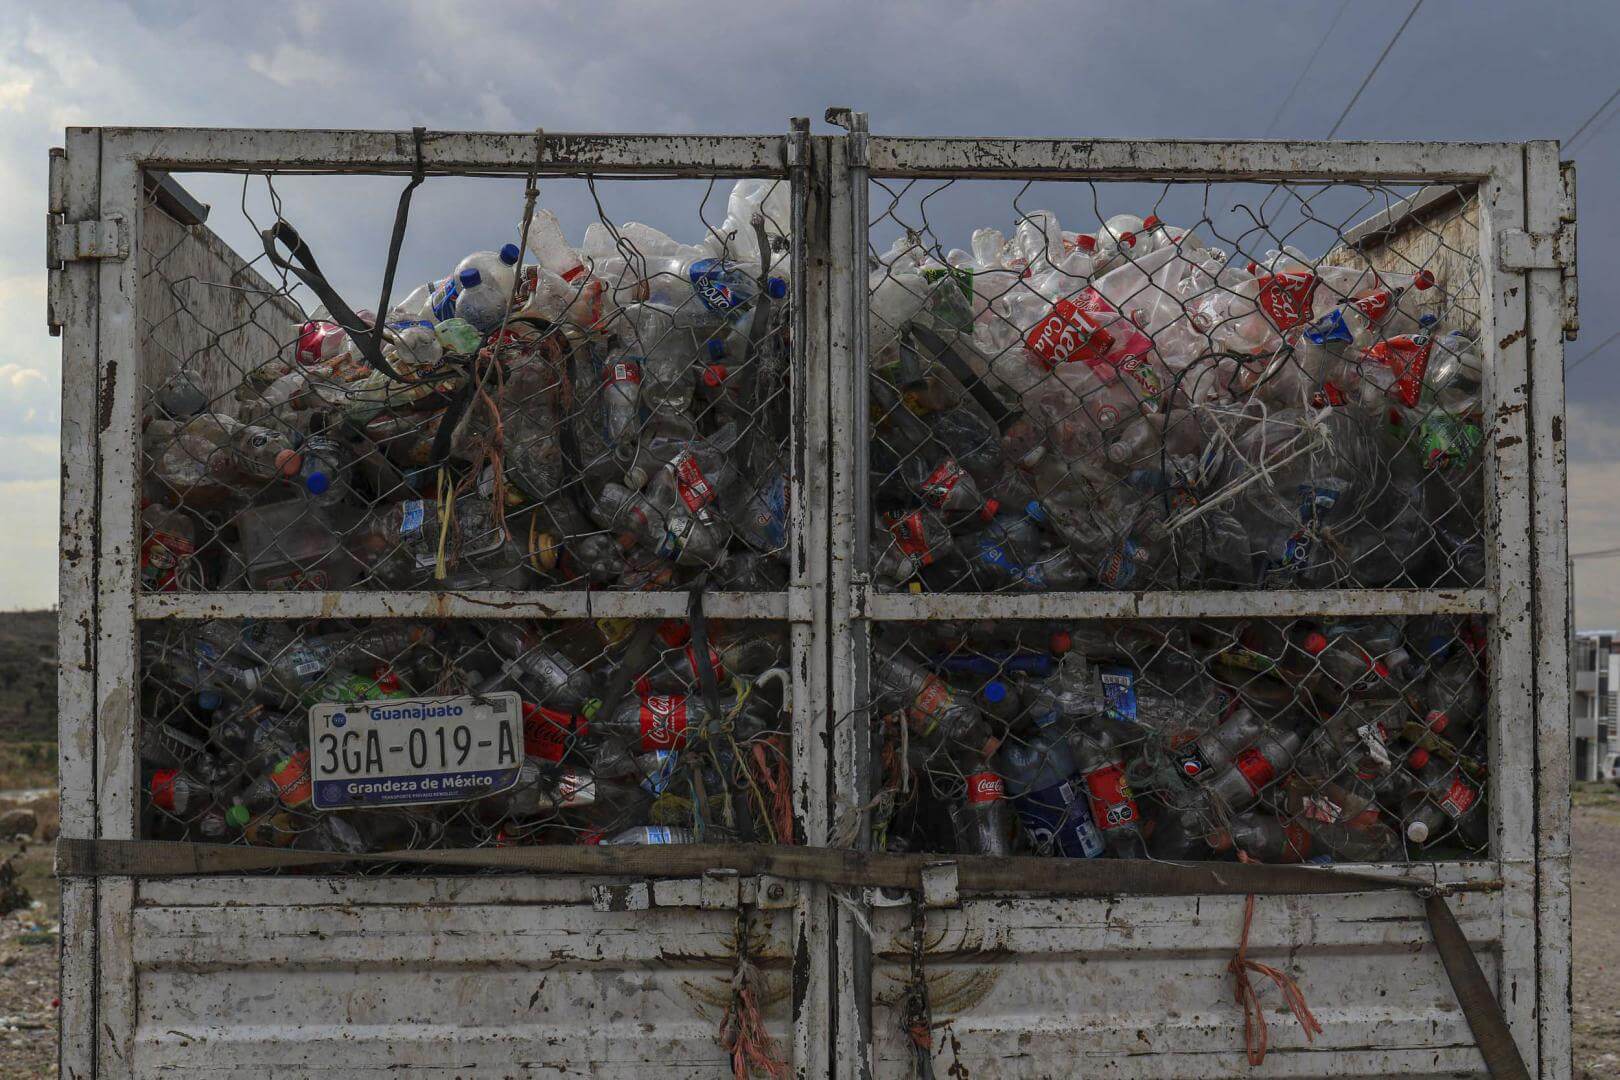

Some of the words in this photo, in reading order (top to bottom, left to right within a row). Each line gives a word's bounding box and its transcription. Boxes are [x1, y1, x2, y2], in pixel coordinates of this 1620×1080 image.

[1034, 316, 1063, 353] Cola
[323, 714, 332, 728] T
[370, 704, 463, 721] Guanajuato
[319, 719, 516, 774] 3GA-019-A
[347, 780, 417, 794] Grandeza
[420, 778, 438, 790] de
[442, 774, 493, 788] México
